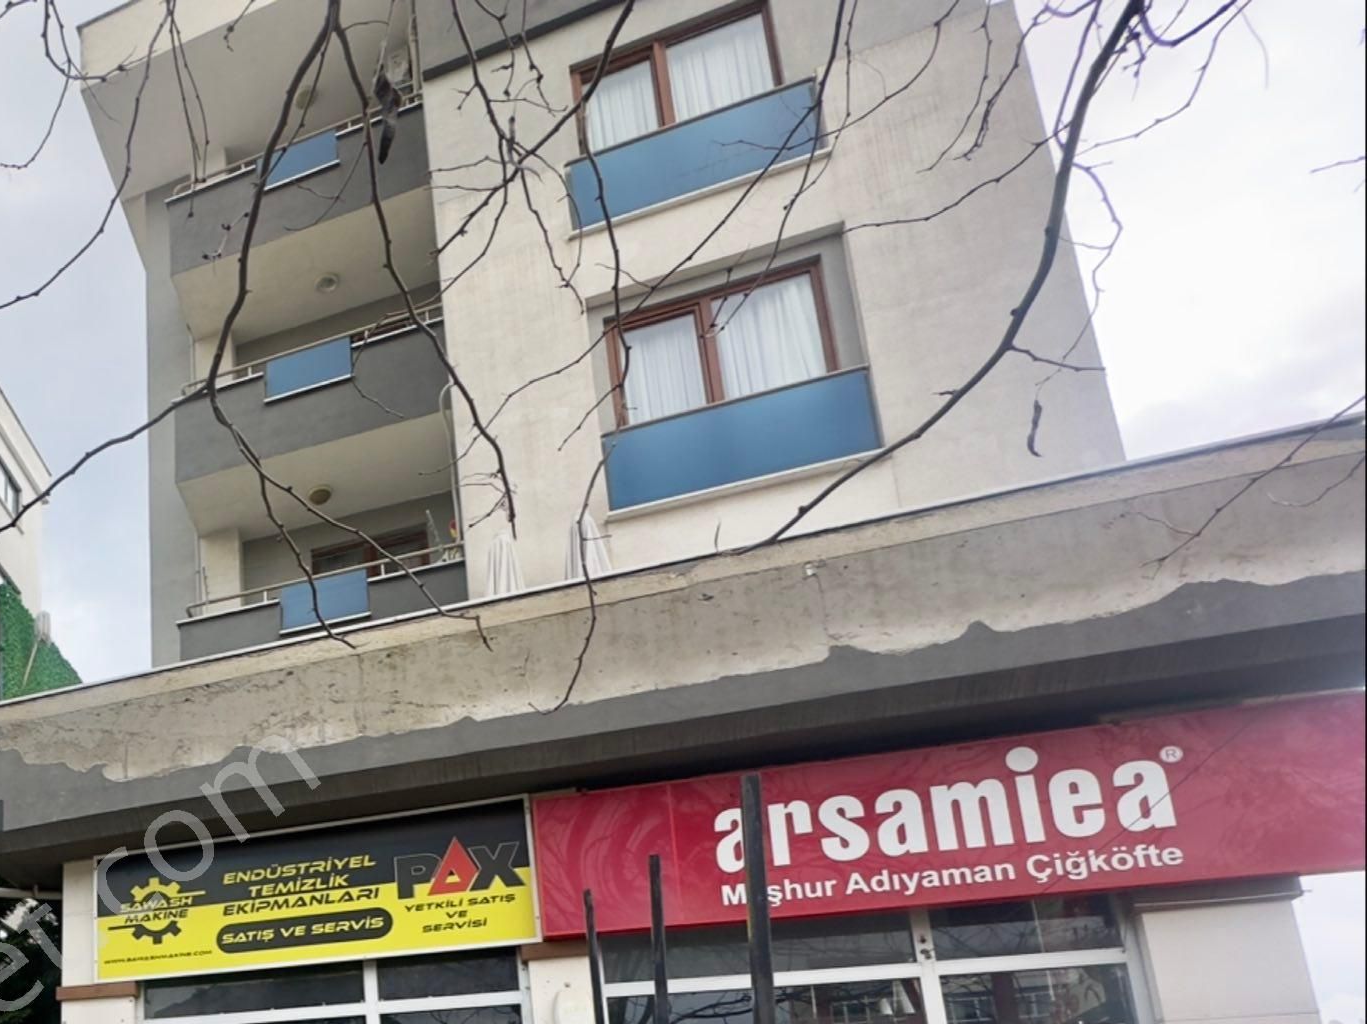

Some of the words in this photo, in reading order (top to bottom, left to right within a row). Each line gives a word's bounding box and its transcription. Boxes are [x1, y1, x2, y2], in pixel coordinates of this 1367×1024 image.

[714, 746, 1178, 874] arsamiea
[222, 854, 377, 885] ENDÜSTRİYEL
[394, 835, 526, 900] PAX
[721, 878, 837, 907] Mşhur
[846, 861, 1016, 896] Adıyaman
[1026, 843, 1184, 883] Çiğköfte
[248, 872, 350, 898] TEMİZLİK
[222, 886, 380, 917] EKİPMANLARI
[404, 897, 463, 913] YETKİLİ
[467, 893, 516, 906] SATIŞ
[445, 909, 469, 919] VE
[221, 928, 275, 945] SATIŞ
[280, 924, 307, 939] VE
[311, 915, 384, 936] SERVİS
[422, 917, 488, 934] SERVİSİ
